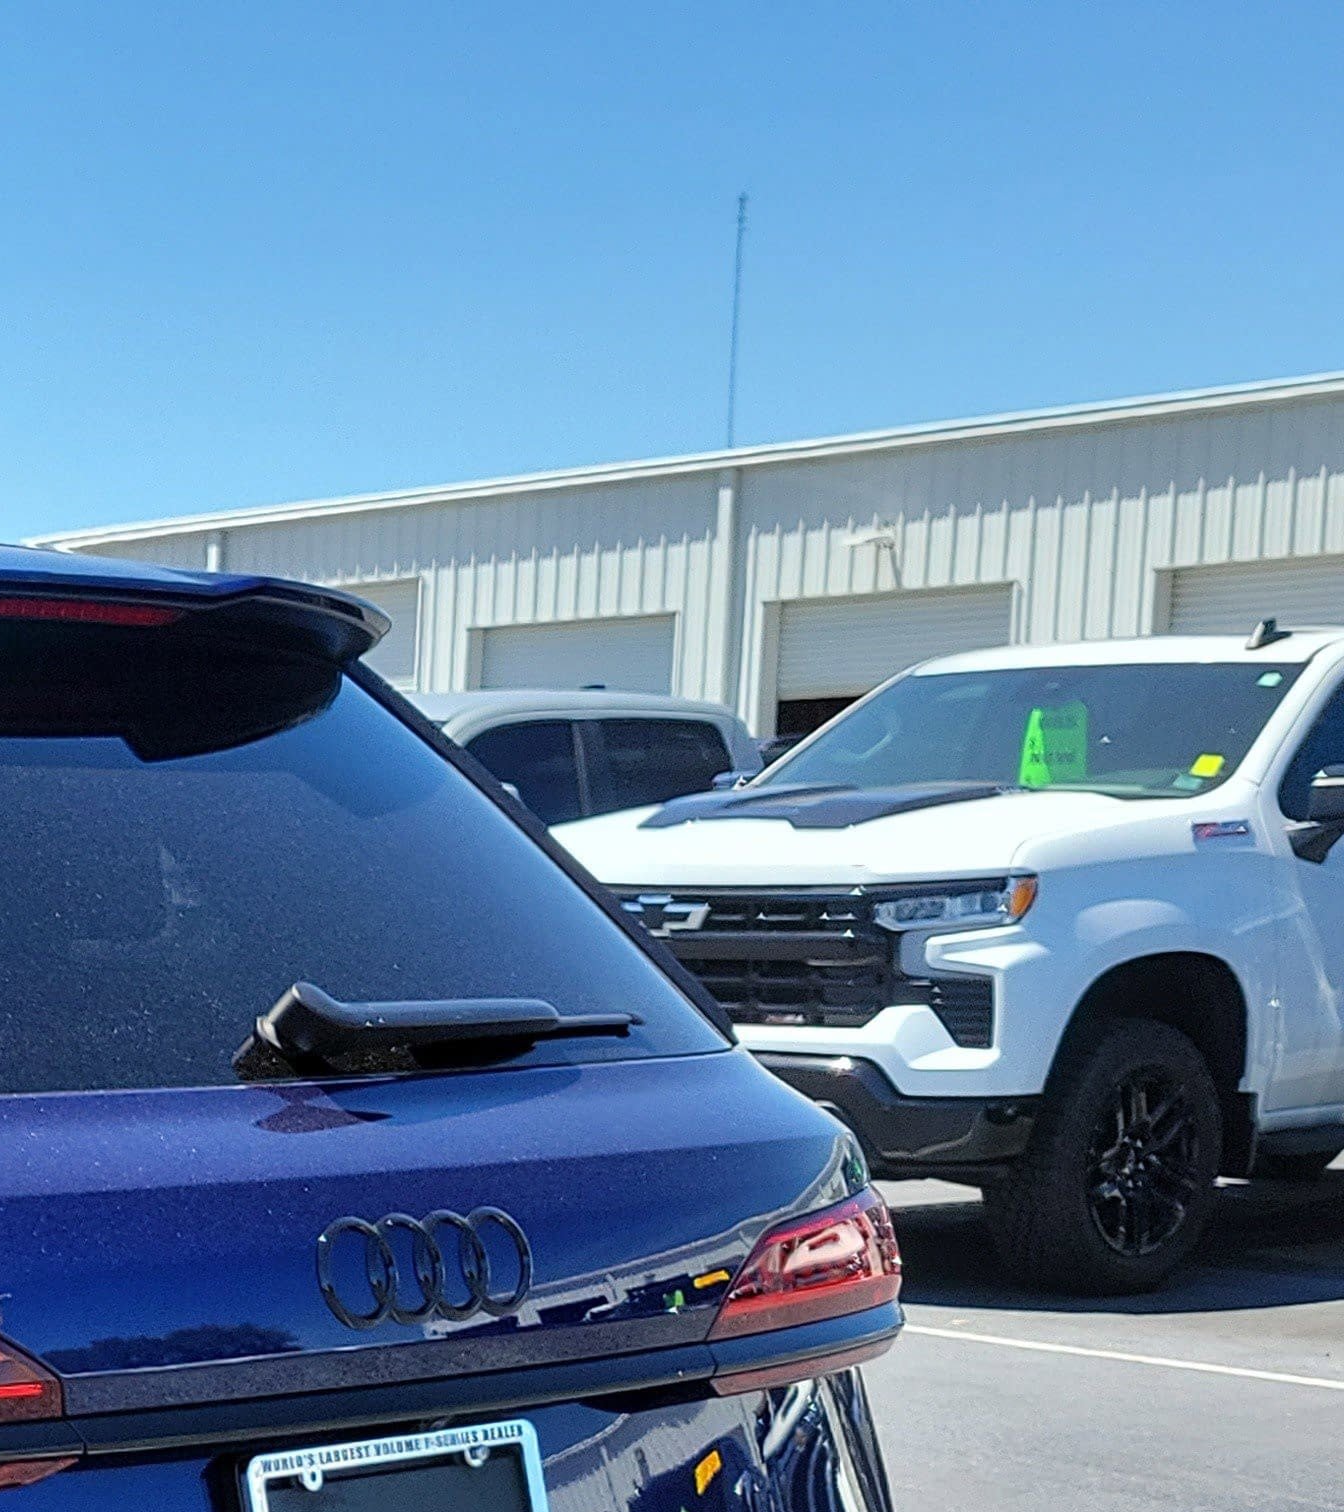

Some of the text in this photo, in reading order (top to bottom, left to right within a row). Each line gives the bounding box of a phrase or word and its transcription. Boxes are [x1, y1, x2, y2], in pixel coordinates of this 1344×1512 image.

[260, 1453, 315, 1472] WORLD'S
[318, 1445, 371, 1465] LARGEST
[373, 1438, 421, 1457] VOLUME
[481, 1424, 525, 1442] DEALER
